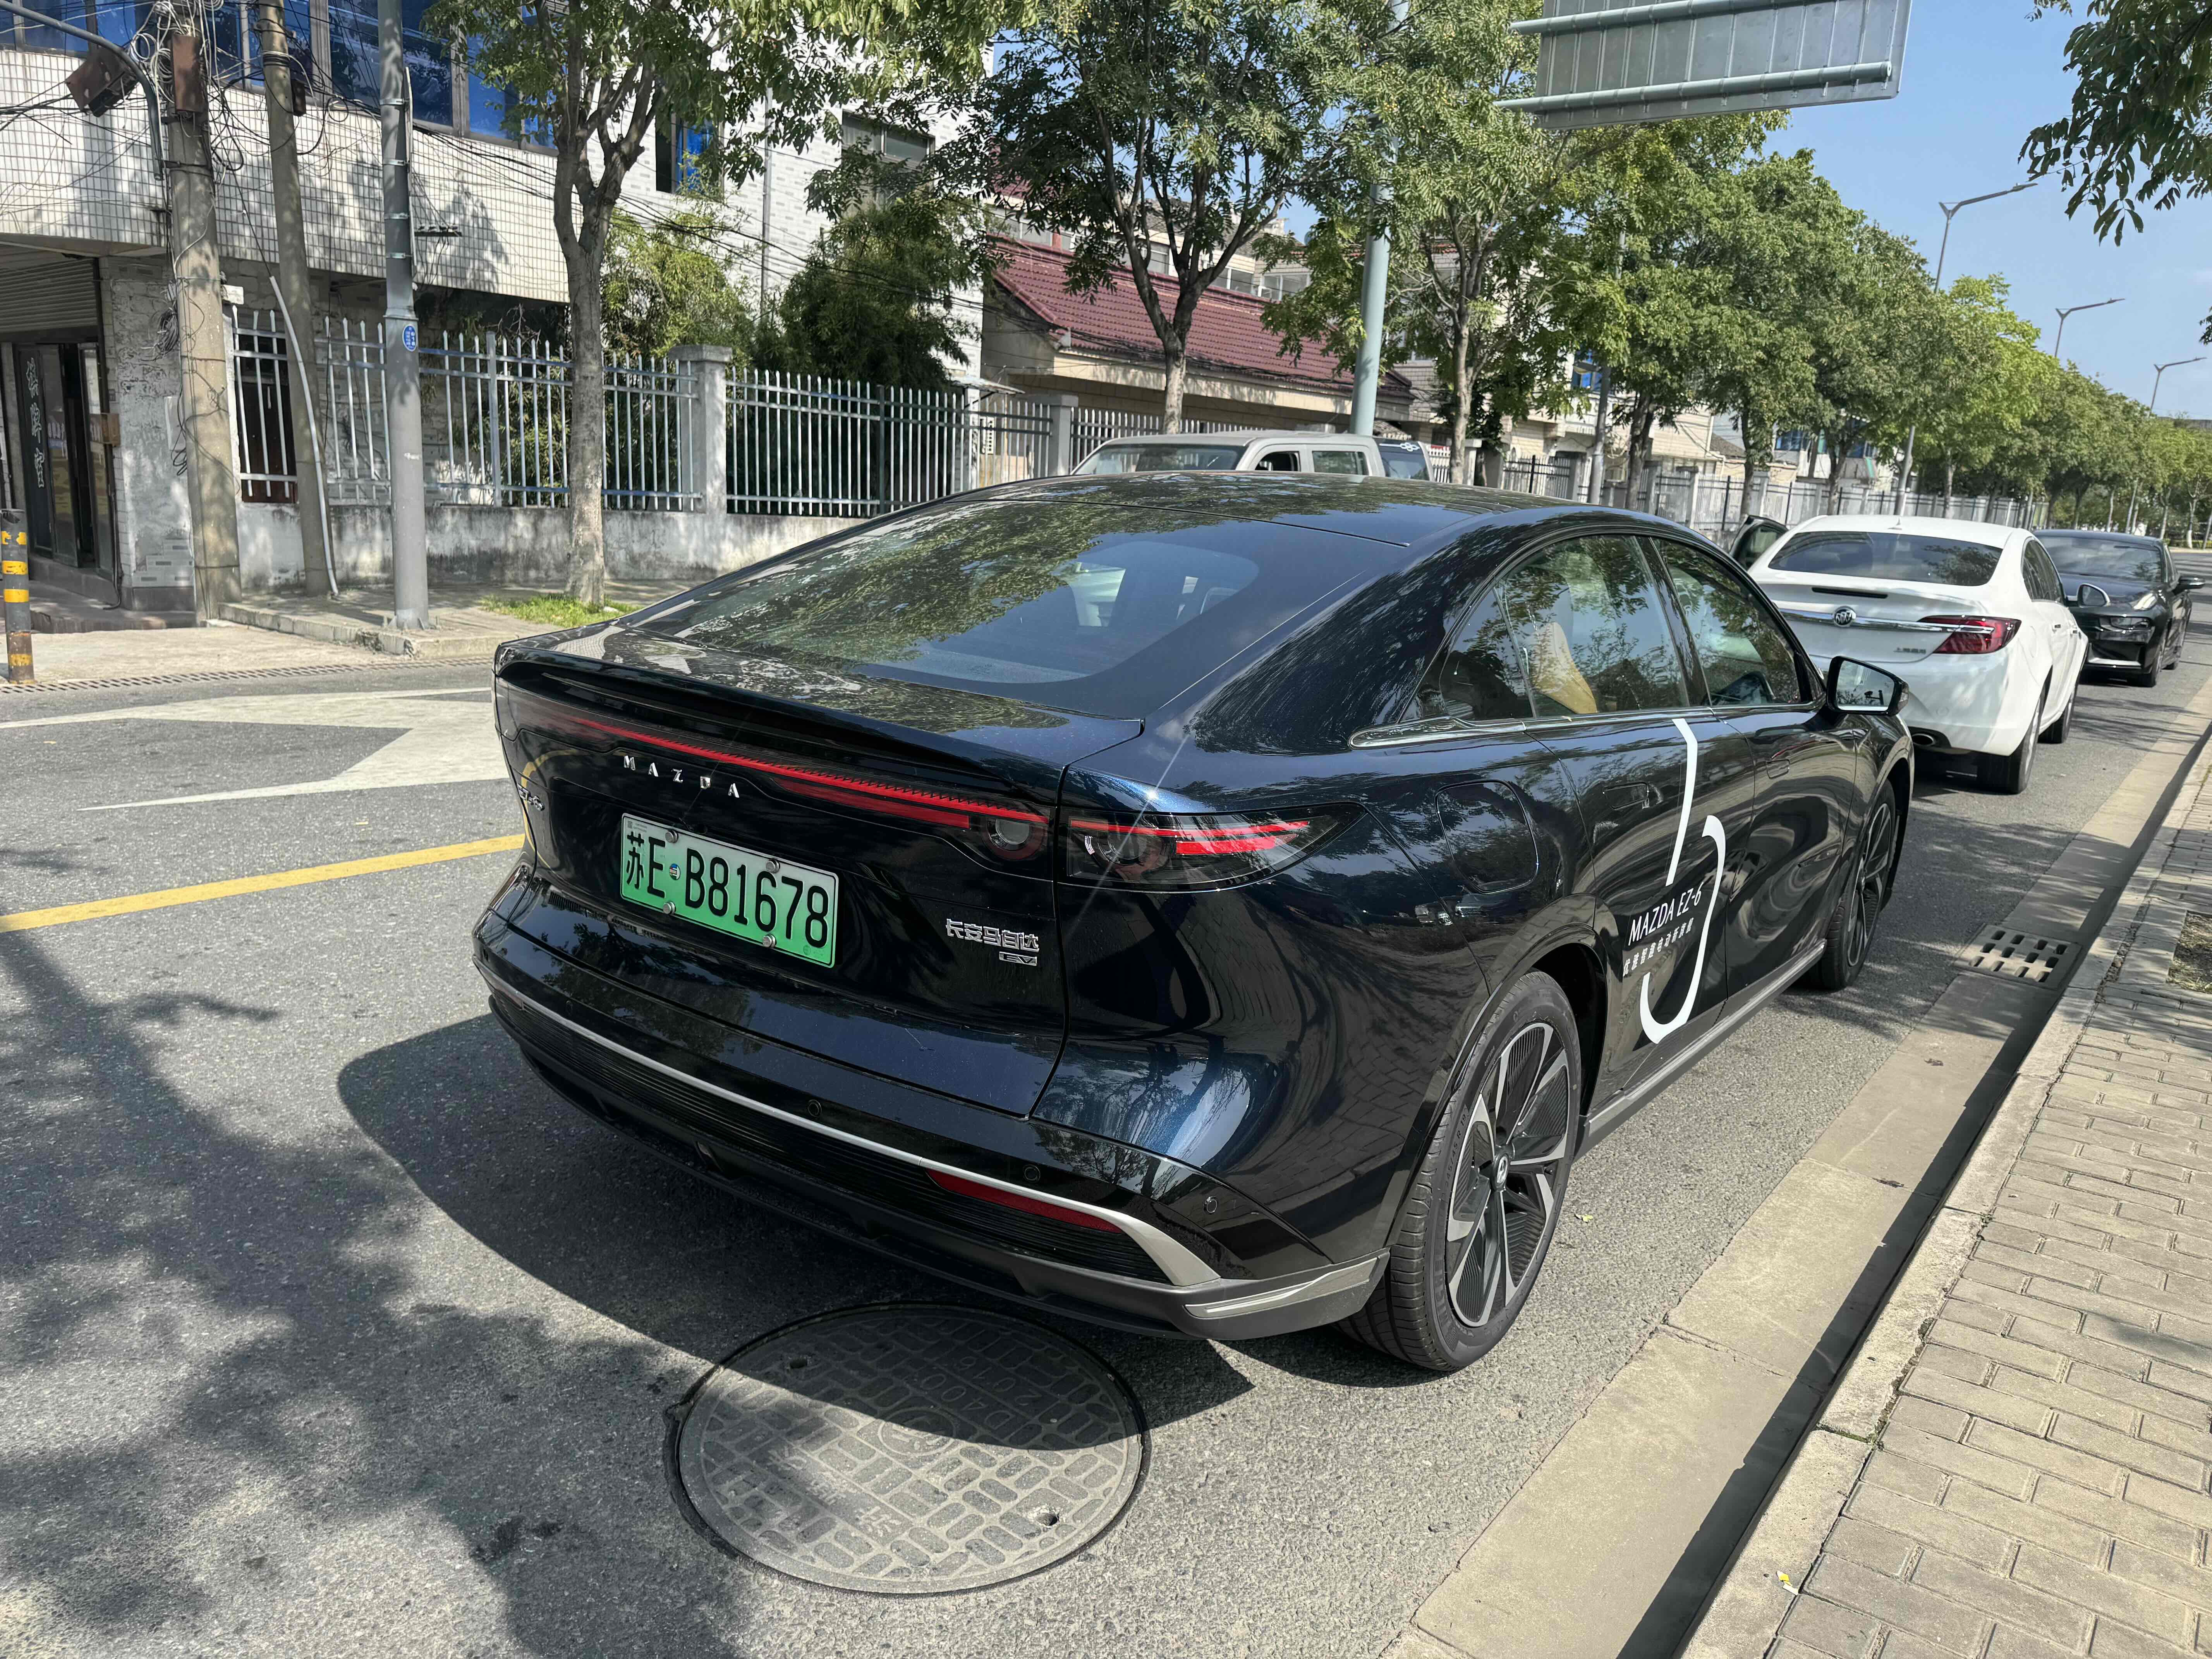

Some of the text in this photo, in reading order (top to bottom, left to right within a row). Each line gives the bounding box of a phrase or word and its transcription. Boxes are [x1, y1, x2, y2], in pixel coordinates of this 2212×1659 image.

[26, 357, 45, 488] 棋牌室
[623, 755, 740, 798] MAZDA
[946, 918, 1040, 952] 长安马自达
[1628, 881, 1704, 946] MAZDA EZ-6
[999, 951, 1037, 966] EV
[1456, 1130, 1462, 1139] R
[1460, 1114, 1466, 1126] 19
[920, 1374, 1016, 1431] D400
[959, 1356, 1042, 1407] 2016
